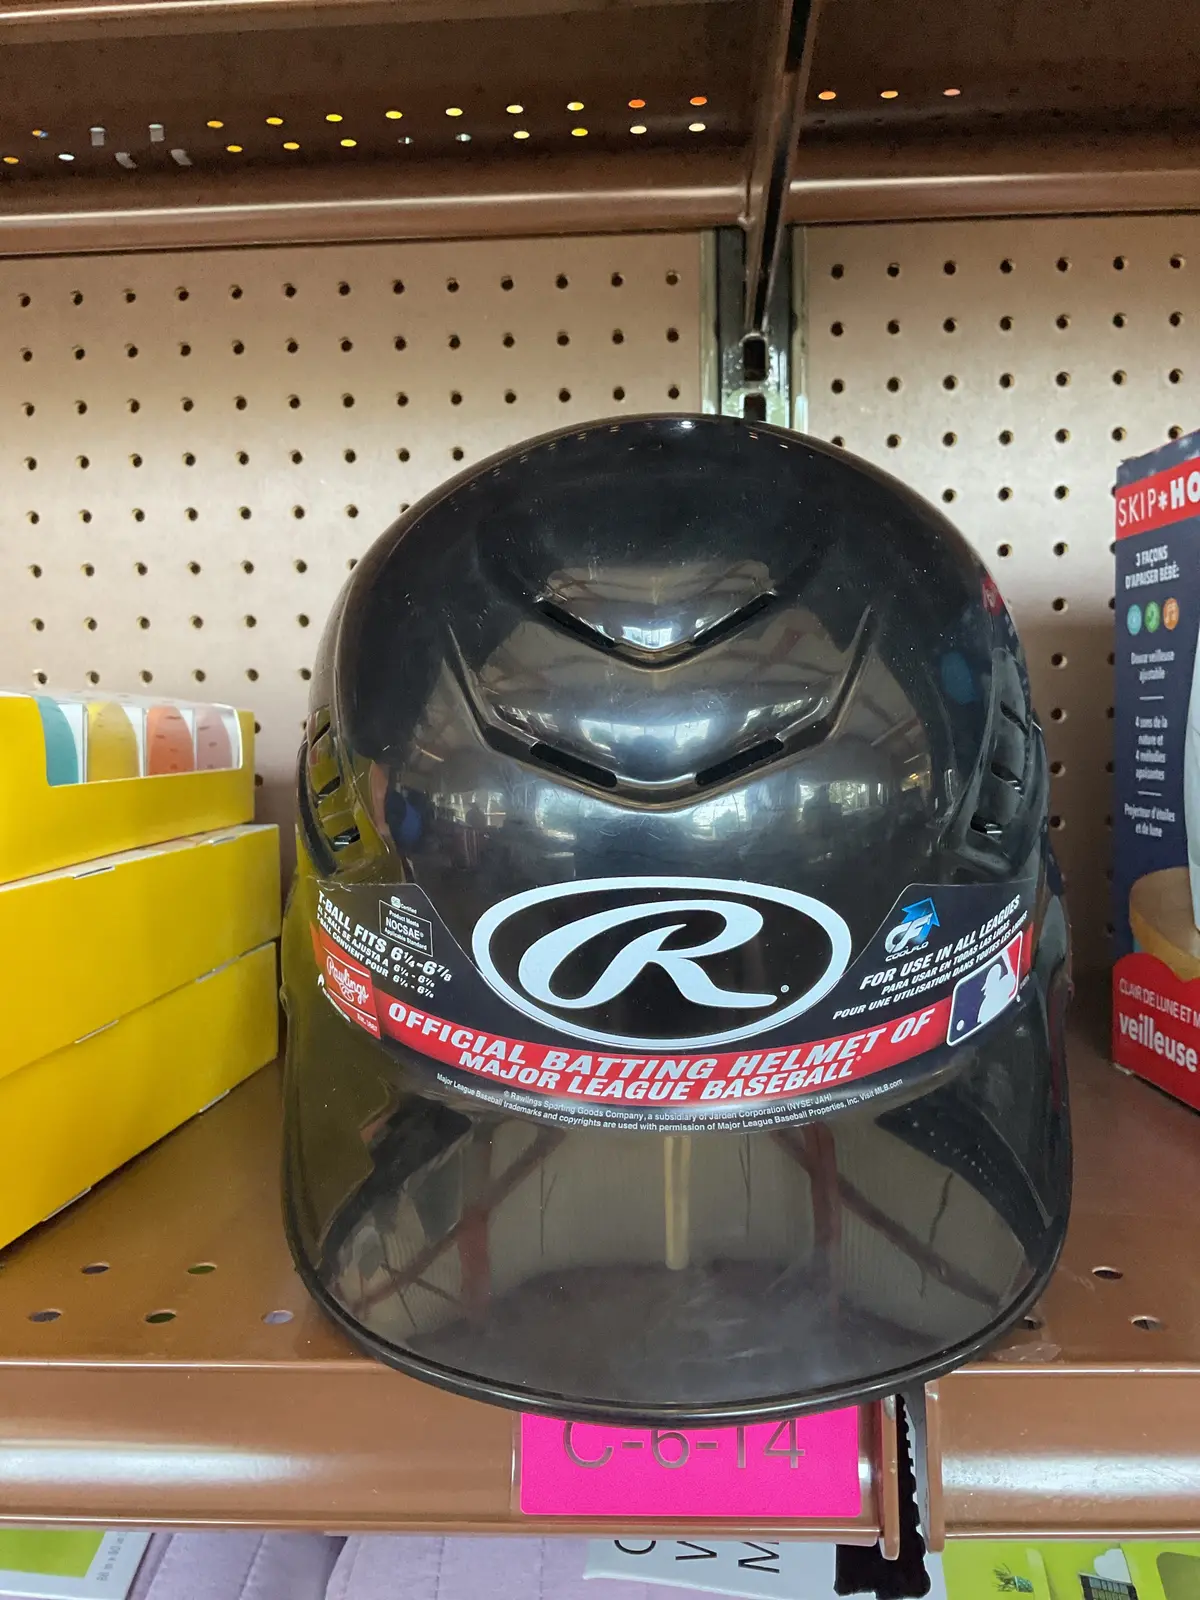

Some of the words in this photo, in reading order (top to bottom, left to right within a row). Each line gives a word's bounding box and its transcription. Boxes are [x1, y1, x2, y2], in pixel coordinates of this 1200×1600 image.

[1118, 488, 1157, 527] SKIP
[1135, 552, 1140, 567] 3
[1141, 545, 1168, 567] FAÇONS
[318, 890, 351, 931] T-BALL
[354, 923, 387, 953] FITS
[324, 911, 341, 934] T-BALL
[342, 930, 351, 942] SE
[352, 938, 381, 963] AJUSTA
[389, 909, 406, 922] Product
[332, 932, 365, 962] CONVIENT
[365, 958, 389, 977] POUR
[859, 968, 897, 990] FOR
[900, 953, 934, 977] USE
[935, 944, 953, 963] IN
[953, 930, 976, 954] ALL
[979, 894, 1020, 939] LEAGUES
[881, 979, 909, 995] PARA
[912, 967, 938, 984] USAR
[939, 959, 952, 972] EN
[953, 944, 978, 965] TODAS
[979, 935, 993, 950] LAS
[326, 955, 369, 1005] Rawlings
[833, 1004, 866, 1020] POUR
[868, 996, 892, 1011] UNE
[893, 970, 952, 1003] UTILISATION
[952, 958, 975, 977] DANS
[1001, 929, 1012, 944] LES
[1119, 977, 1142, 1001] CLAIR
[1142, 990, 1156, 1006] DE
[1155, 994, 1179, 1019] LUNE
[1180, 1004, 1192, 1024] ET
[388, 1003, 527, 1064] OFFICIAL
[540, 1051, 717, 1080] BATTING
[728, 1027, 886, 1078] HELMET
[890, 1008, 936, 1044] OF
[1119, 1012, 1198, 1073] veilleuse
[458, 1051, 560, 1089] MAJOR
[567, 1076, 695, 1100] LEAGUE
[700, 1058, 854, 1100] BASEBALL
[437, 1073, 453, 1086] Major
[453, 1081, 475, 1095] League
[476, 1090, 503, 1106] Baseball
[504, 1100, 542, 1117] trademarks
[543, 1110, 558, 1120] and
[559, 1115, 601, 1127] copyrights
[618, 1122, 638, 1130] used
[640, 1122, 657, 1131] with
[659, 1123, 705, 1132] permission
[707, 1122, 716, 1130] of
[717, 1121, 740, 1131] Major
[742, 1117, 773, 1128] League
[774, 1111, 808, 1124] Baseball
[808, 1103, 846, 1117] Properties,
[847, 1097, 860, 1107] Inc.
[860, 1090, 875, 1101] Visit
[874, 1078, 903, 1095] MLB.com
[511, 1091, 542, 1107] Rawlings
[543, 1100, 575, 1115] Sporting
[577, 1107, 603, 1117] Goods
[605, 1110, 647, 1122] Company,
[655, 1112, 697, 1122] subsidiary
[699, 1112, 708, 1120] of
[709, 1110, 737, 1120] Jarden
[738, 1104, 786, 1118] Corporation
